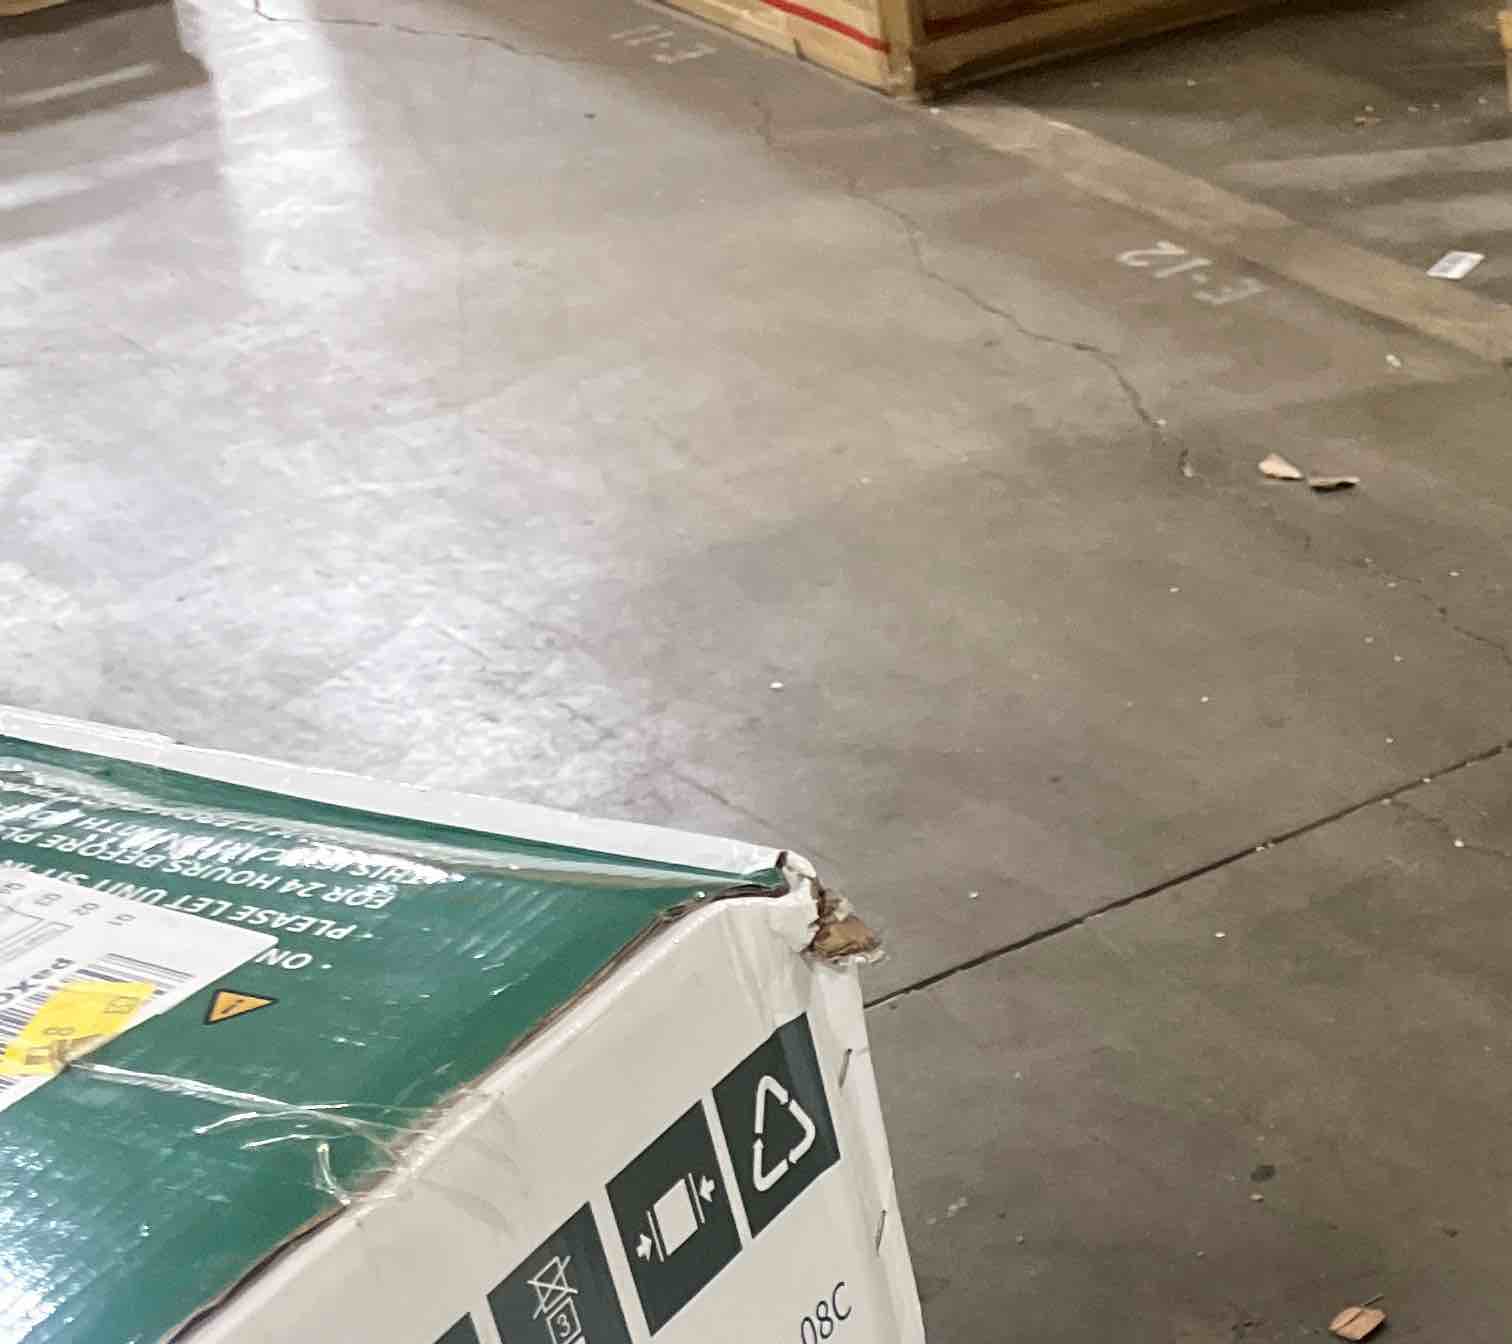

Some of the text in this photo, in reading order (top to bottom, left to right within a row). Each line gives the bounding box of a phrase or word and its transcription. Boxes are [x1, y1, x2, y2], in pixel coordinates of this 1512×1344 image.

[37, 834, 168, 868] BEFORE
[162, 860, 281, 889] HOURS
[279, 879, 326, 897] 24
[162, 895, 232, 916] LET
[322, 882, 397, 909] FOR
[228, 905, 357, 939] PLEASE
[556, 1314, 570, 1337] 3
